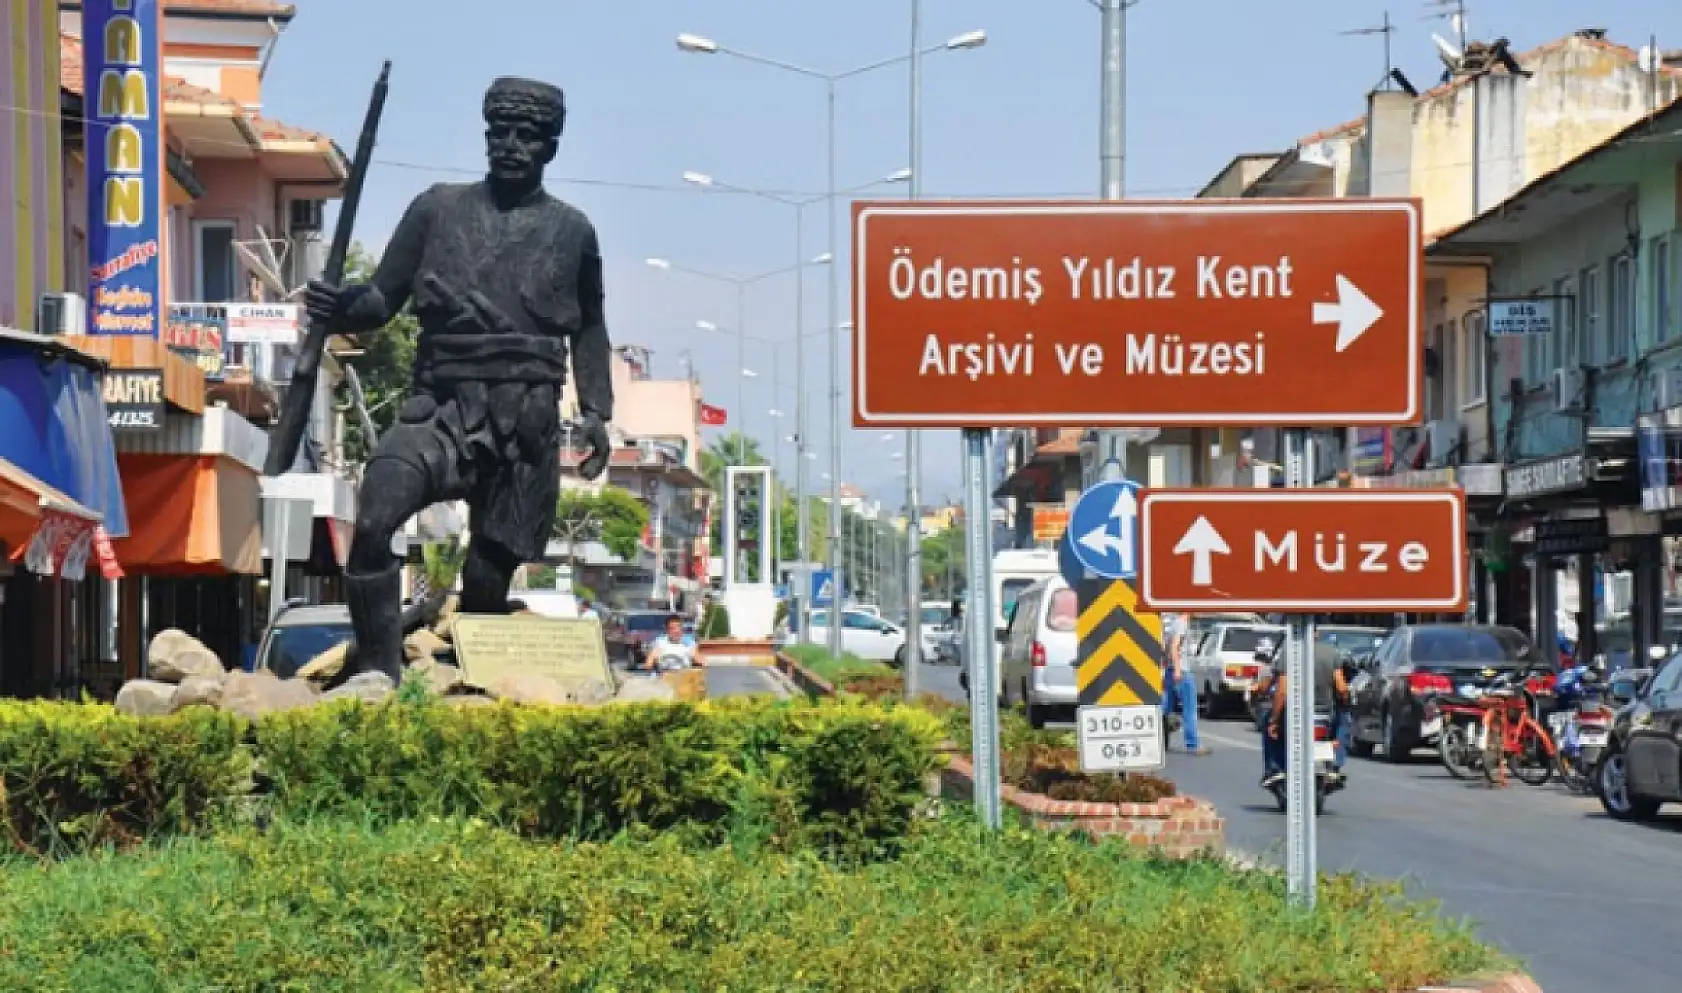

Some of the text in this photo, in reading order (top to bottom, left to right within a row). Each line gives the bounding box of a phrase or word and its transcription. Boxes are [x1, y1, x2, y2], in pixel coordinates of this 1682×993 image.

[100, 0, 149, 228] AMAN
[889, 248, 1293, 305] Ödemiş Yıldız Kent
[919, 331, 1266, 381] Arşivi ve Müzesi
[1254, 530, 1430, 573] Müze
[1102, 743, 1141, 759] 063
